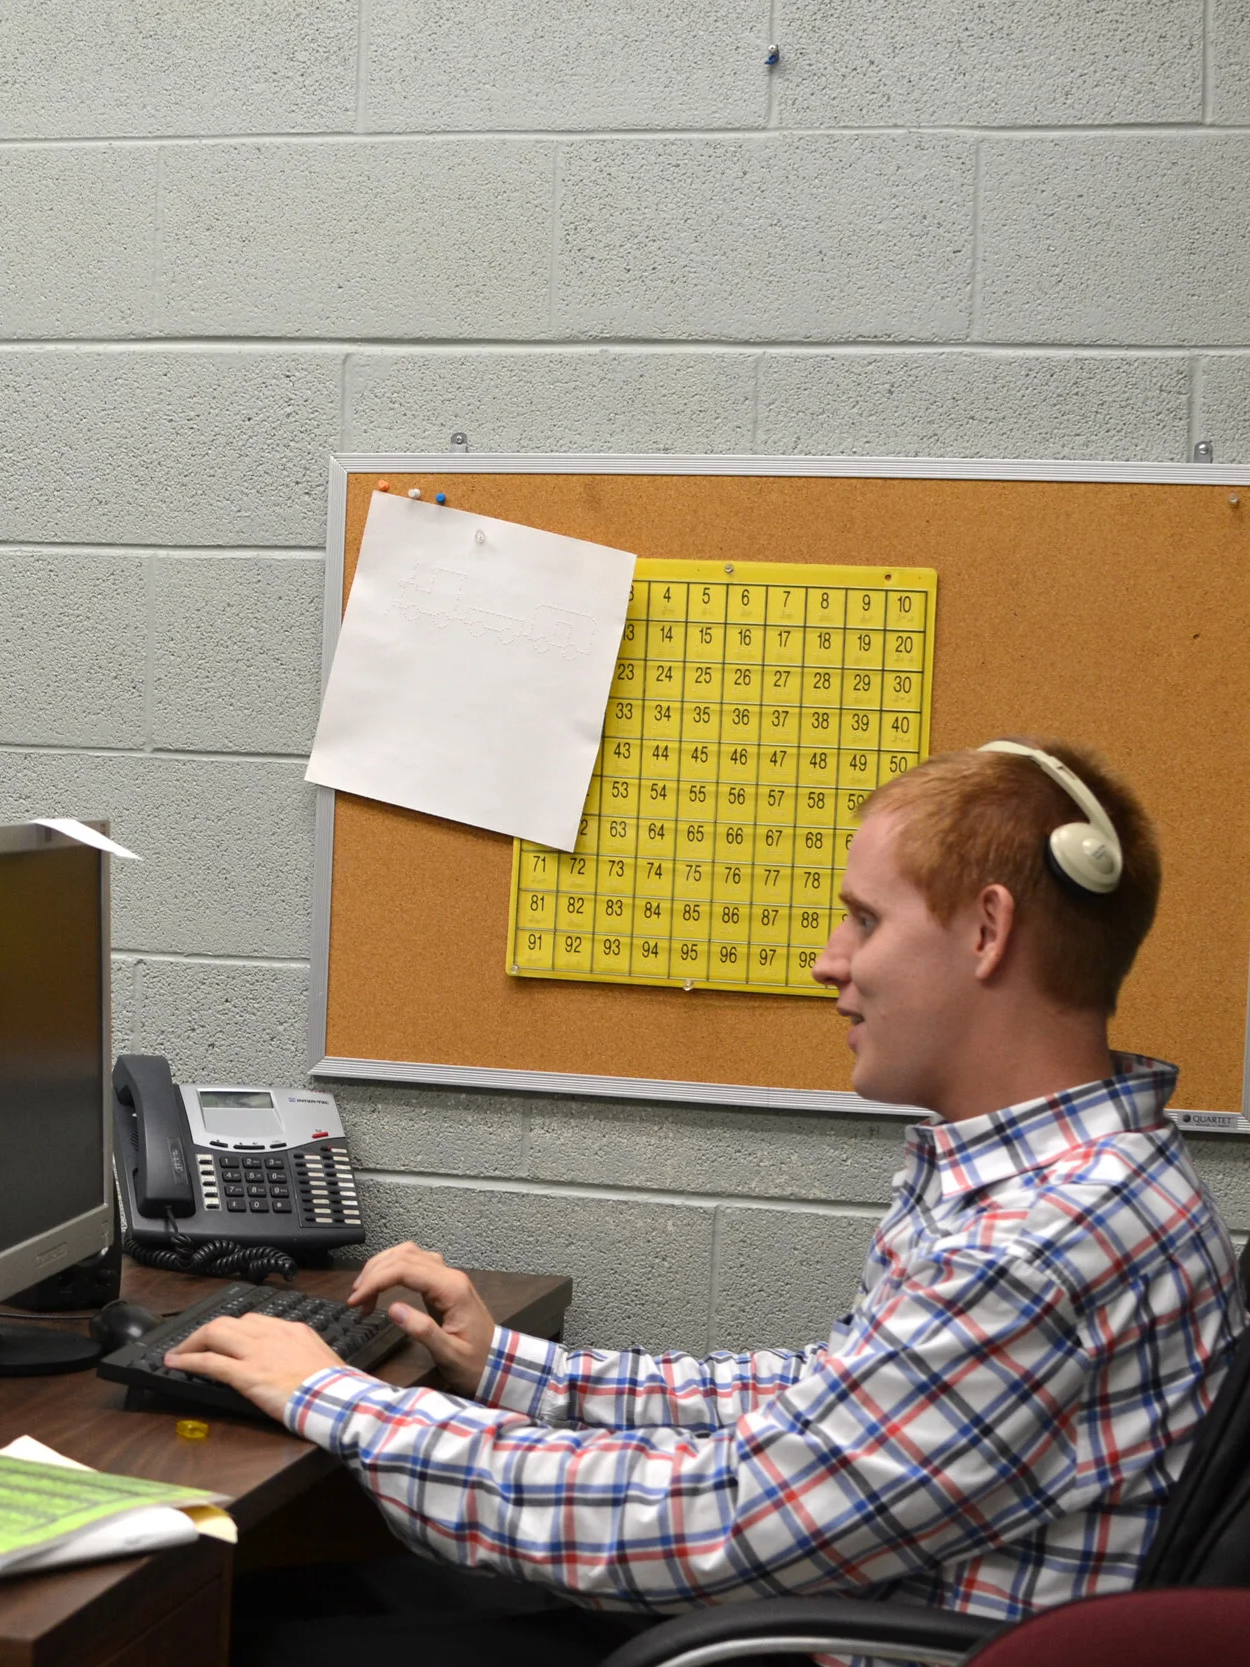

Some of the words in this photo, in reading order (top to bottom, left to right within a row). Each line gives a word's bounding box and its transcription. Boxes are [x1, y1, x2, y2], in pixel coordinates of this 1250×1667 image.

[663, 586, 672, 603] 4
[702, 587, 711, 605] 5
[741, 588, 750, 607] 6
[783, 590, 791, 608] 7
[820, 591, 830, 610] 8
[862, 593, 871, 612] 9
[897, 595, 912, 614] 10
[660, 625, 673, 643] 14
[698, 626, 713, 645] 15
[738, 628, 752, 646] 16
[777, 630, 791, 648] 17
[817, 631, 832, 650] 18
[857, 633, 872, 652] 19
[895, 635, 913, 654] 20
[617, 663, 635, 681] 23
[655, 664, 673, 682] 24
[694, 666, 712, 684] 25
[733, 668, 752, 686] 26
[773, 670, 791, 688] 27
[813, 671, 831, 690] 28
[853, 673, 871, 692] 29
[893, 675, 912, 694] 30
[615, 701, 633, 720] 33
[654, 704, 672, 722] 34
[693, 705, 711, 724] 35
[732, 707, 750, 726] 36
[771, 709, 790, 727] 37
[811, 711, 830, 730] 38
[851, 713, 870, 732] 39
[891, 716, 910, 734] 40
[613, 741, 631, 760] 43
[652, 744, 669, 761] 44
[690, 745, 709, 764] 45
[730, 748, 748, 766] 46
[769, 750, 787, 767] 47
[809, 751, 828, 770] 48
[849, 753, 868, 772] 49
[889, 755, 908, 774] 50
[611, 780, 629, 799] 53
[650, 783, 668, 801] 54
[689, 784, 707, 803] 55
[728, 787, 746, 806] 56
[767, 789, 785, 807] 57
[807, 791, 825, 810] 58
[609, 820, 627, 838] 63
[648, 822, 666, 840] 64
[686, 824, 705, 843] 65
[725, 826, 744, 845] 66
[765, 829, 783, 847] 67
[805, 831, 823, 850] 68
[533, 855, 547, 873] 71
[569, 857, 586, 875] 72
[607, 859, 625, 878] 73
[646, 862, 663, 880] 74
[685, 864, 702, 882] 75
[724, 866, 741, 885] 76
[764, 868, 781, 887] 77
[803, 871, 821, 890] 78
[530, 894, 545, 912] 81
[566, 896, 585, 915] 82
[605, 898, 623, 917] 83
[643, 901, 662, 919] 84
[682, 903, 701, 922] 85
[721, 906, 740, 925] 86
[761, 908, 779, 926] 87
[800, 911, 819, 929] 88
[527, 933, 542, 951] 91
[564, 935, 582, 954] 92
[603, 938, 621, 956] 93
[641, 940, 659, 959] 94
[680, 943, 698, 961] 95
[719, 945, 738, 964] 96
[759, 948, 777, 966] 97
[798, 951, 817, 969] 98
[1193, 1115, 1232, 1124] QUARTET
